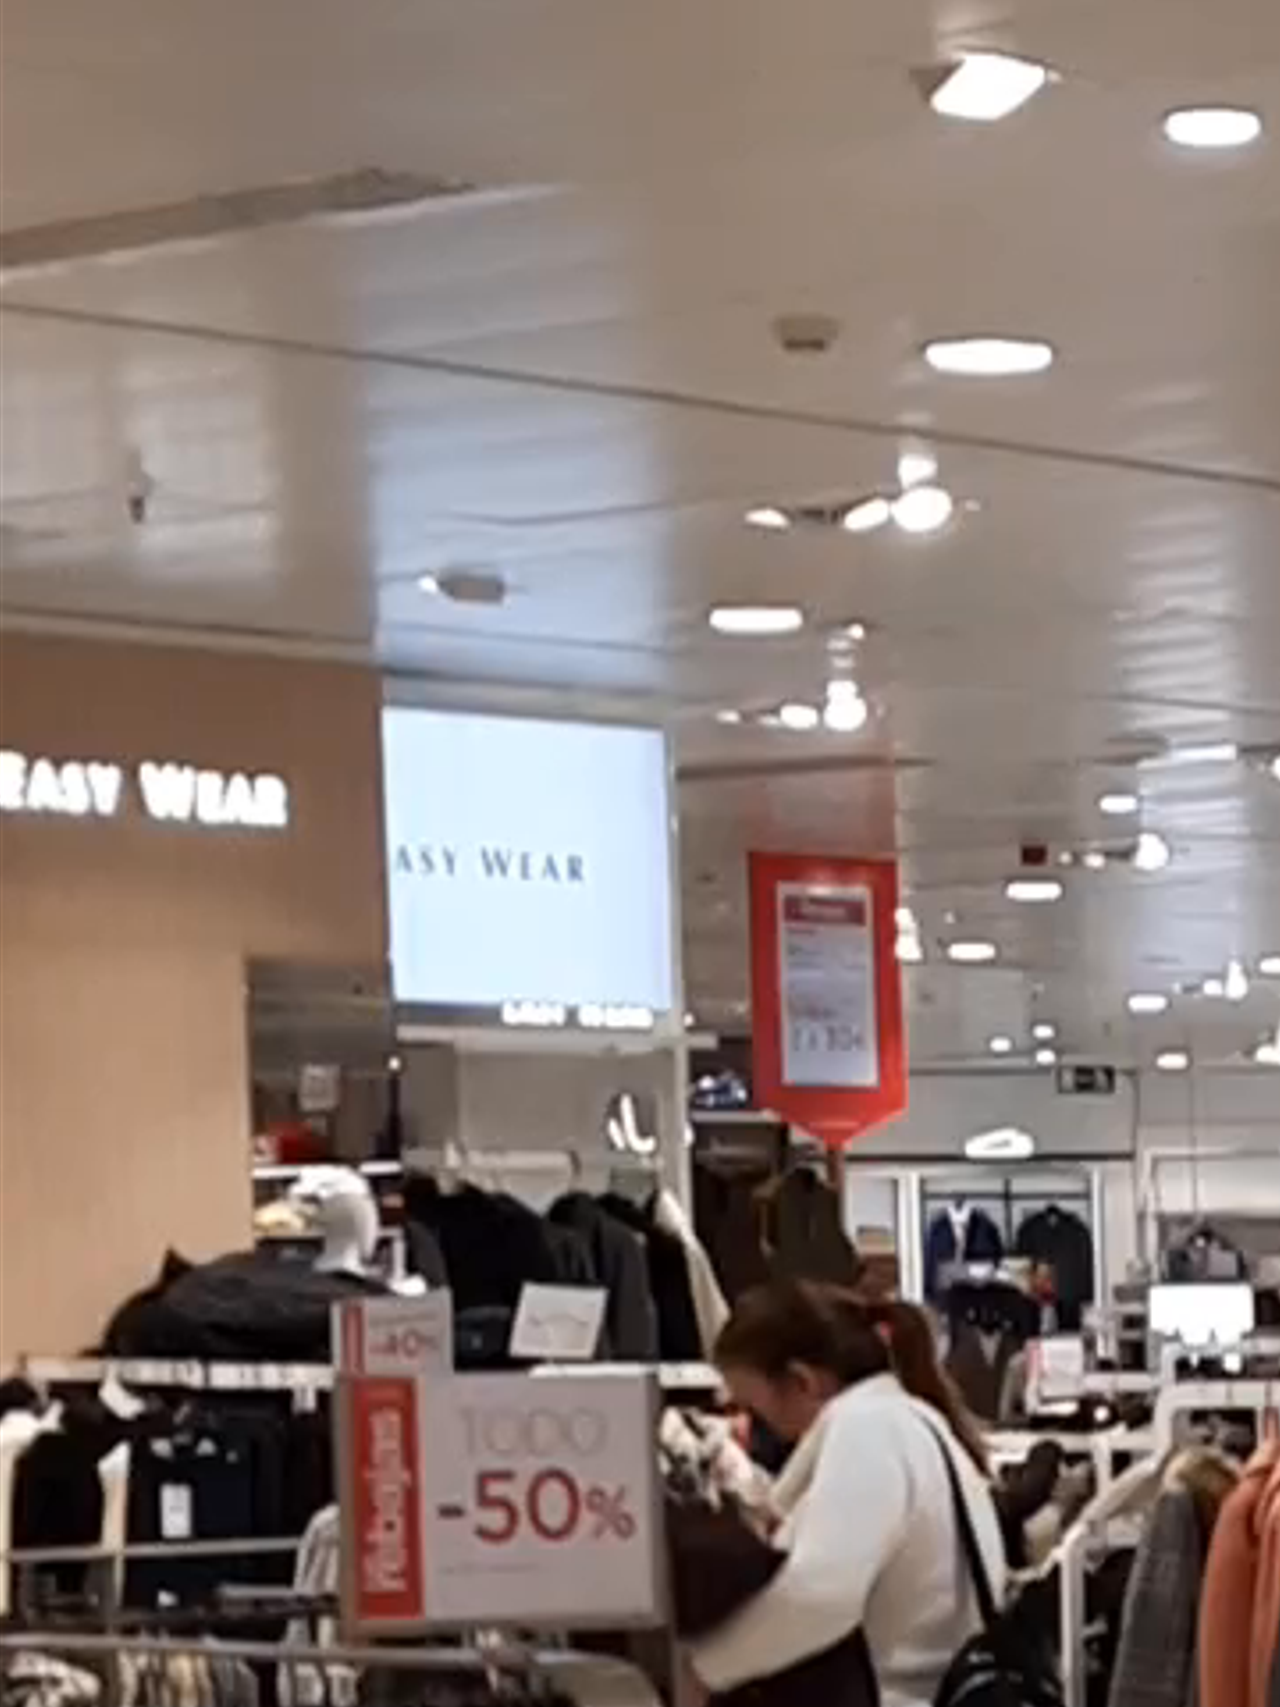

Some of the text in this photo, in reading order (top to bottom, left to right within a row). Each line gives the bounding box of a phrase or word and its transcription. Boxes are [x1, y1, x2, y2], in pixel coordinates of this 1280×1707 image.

[0, 749, 288, 826] EASY WEAR
[396, 844, 586, 883] ASY WEAR
[458, 1406, 607, 1458] TODO
[436, 1465, 637, 1545] -50%
